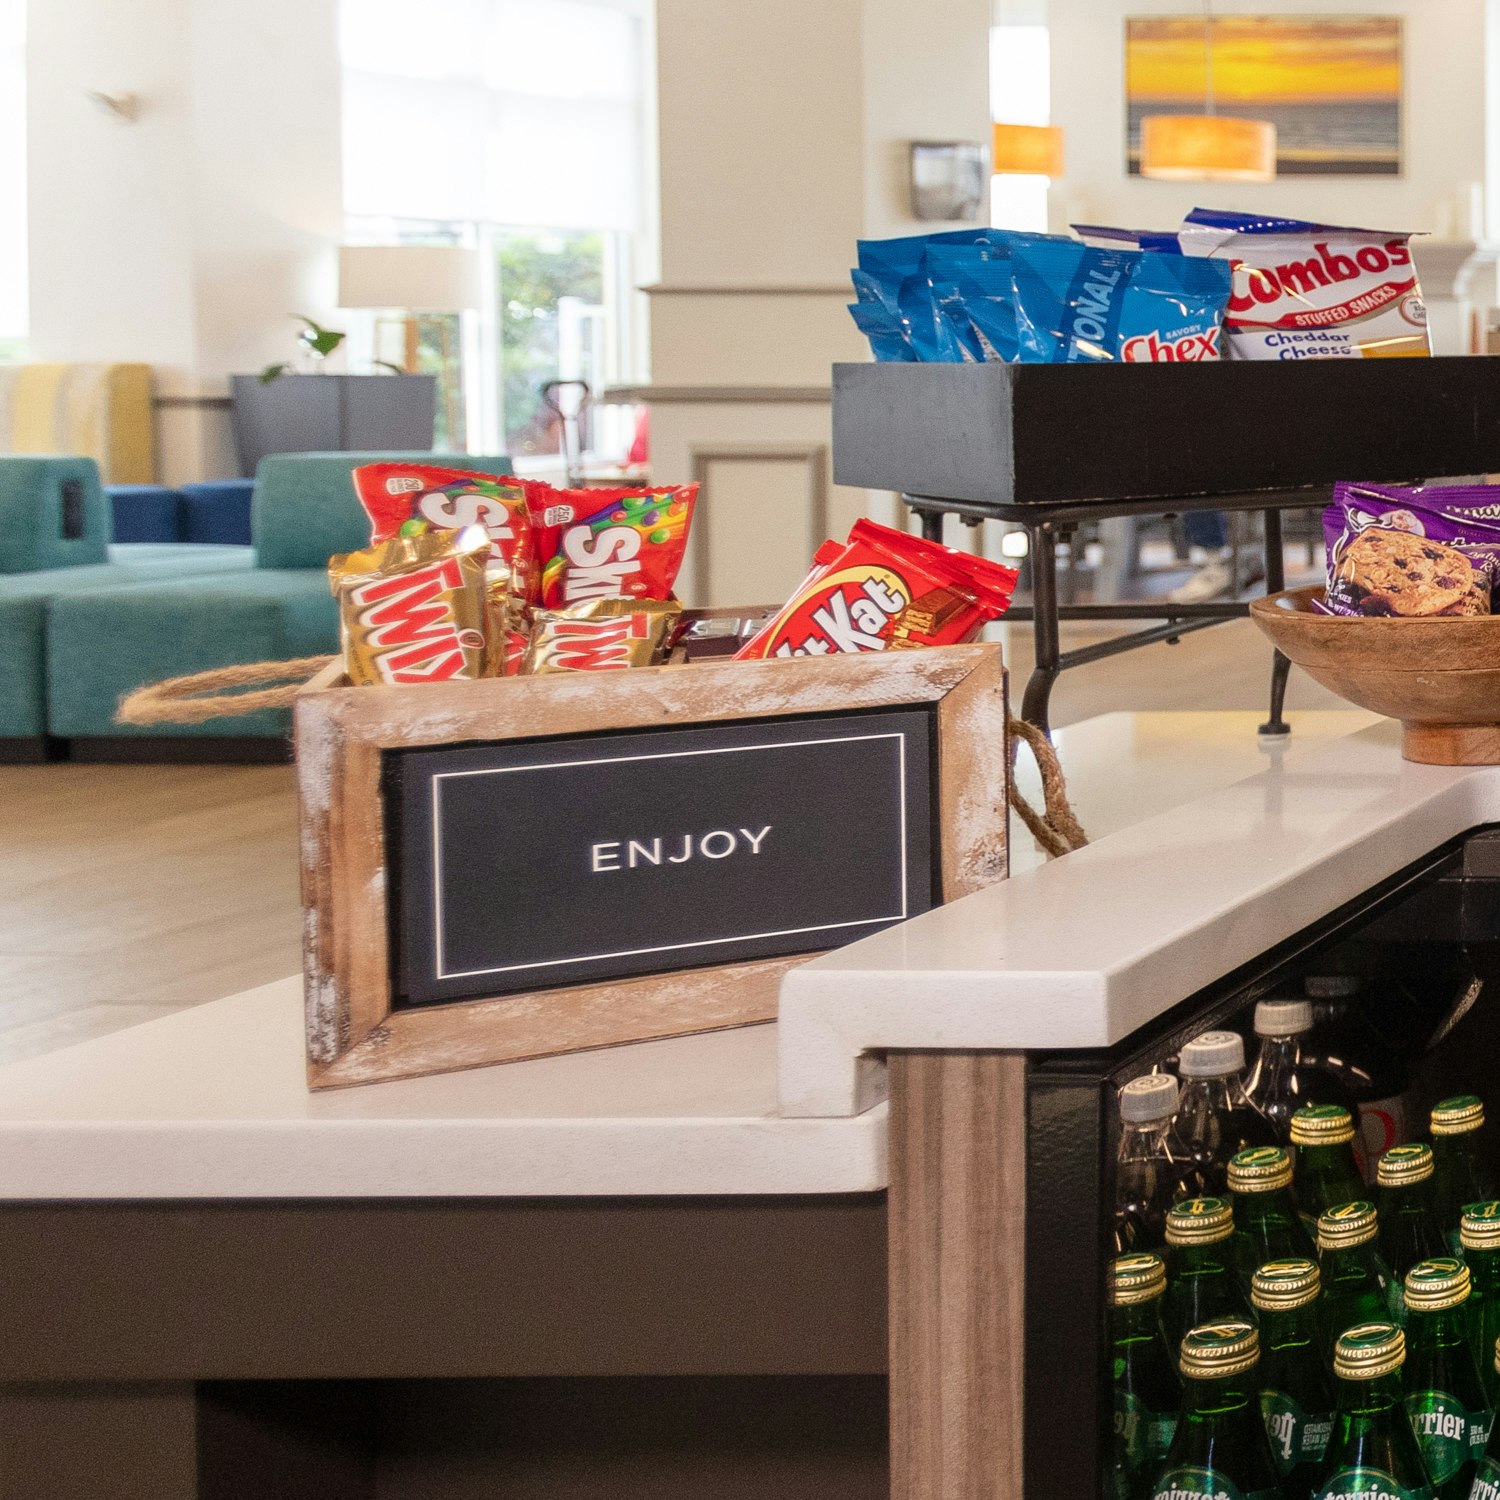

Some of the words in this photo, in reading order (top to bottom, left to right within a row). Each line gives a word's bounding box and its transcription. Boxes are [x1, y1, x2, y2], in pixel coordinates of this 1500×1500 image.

[1295, 305, 1350, 327] STUFFED
[1348, 285, 1397, 315] SNACKS
[1165, 324, 1202, 339] SAVORY
[1265, 332, 1351, 348] Cheddar
[1121, 326, 1221, 363] Chex
[1279, 345, 1352, 361] Cheese
[558, 506, 570, 523] 250
[591, 825, 773, 873] ENJOY
